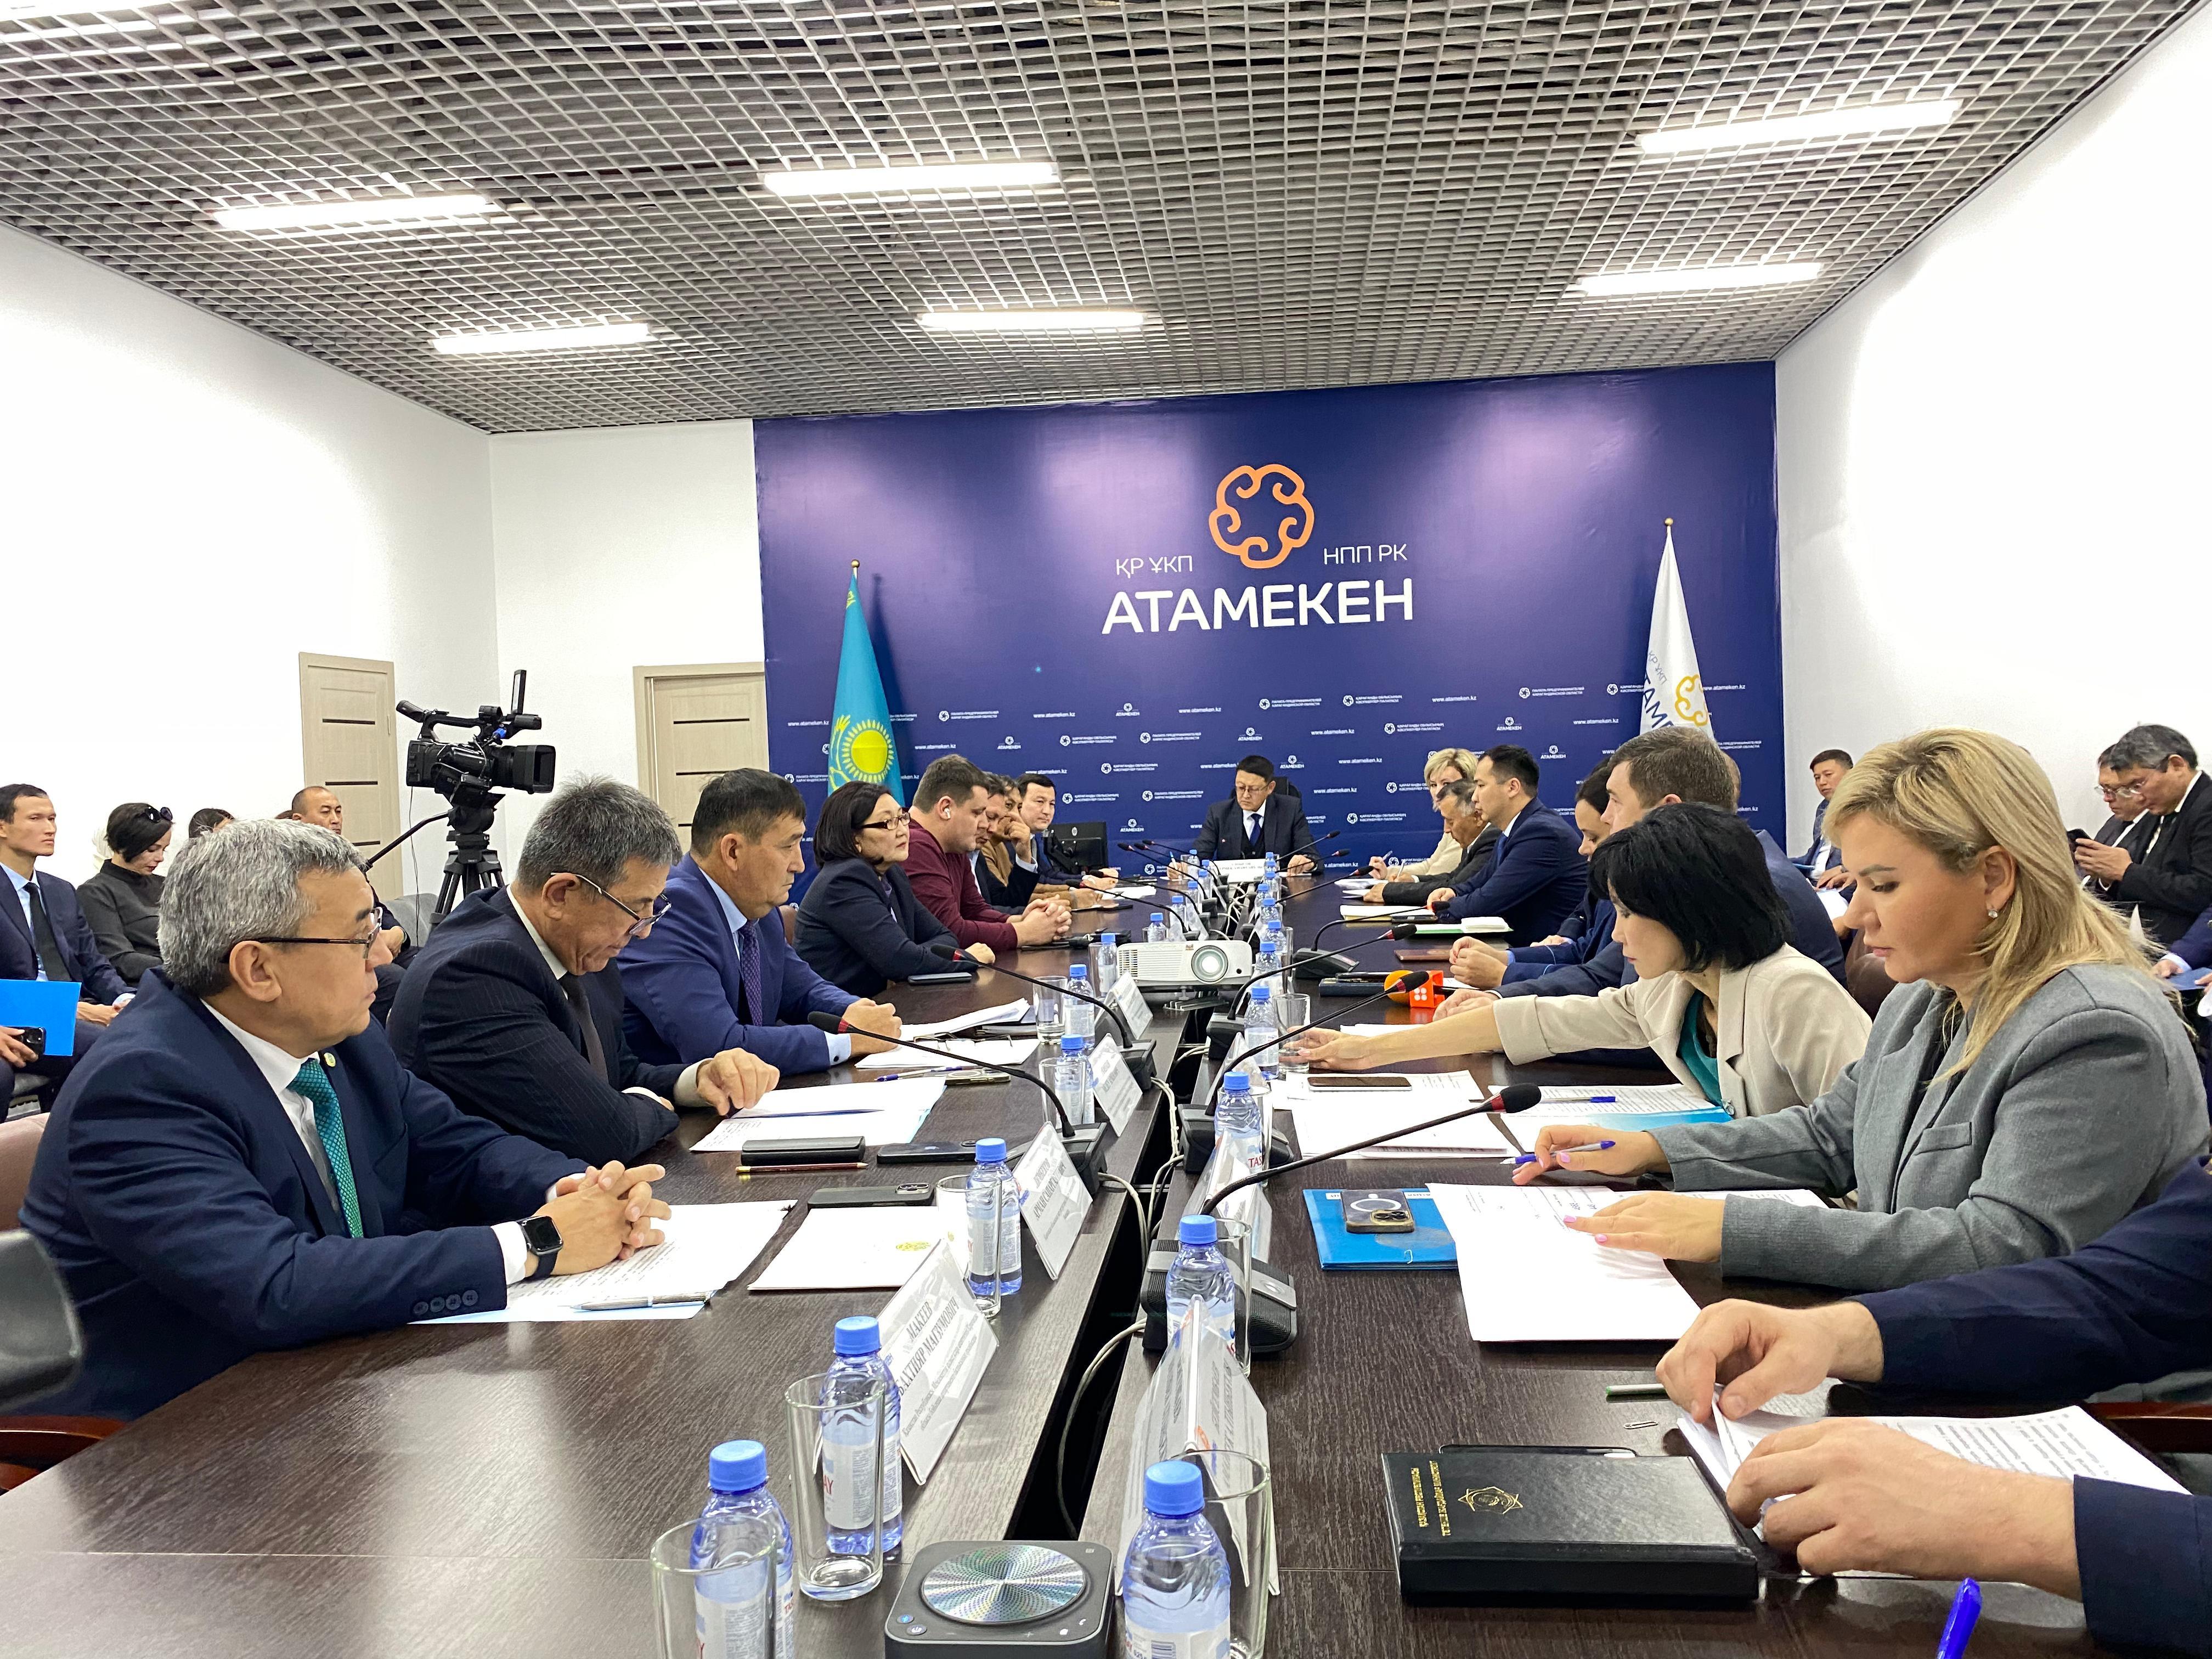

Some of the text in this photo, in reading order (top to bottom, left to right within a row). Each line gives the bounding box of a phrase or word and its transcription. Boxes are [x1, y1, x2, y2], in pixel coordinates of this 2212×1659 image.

[1115, 555, 1193, 578] ҚР ҰКП
[1323, 543, 1408, 565] НПП РК
[1101, 578, 1413, 635] АТАМЕКЕН
[906, 1301, 934, 1344] МАКЕЕВ
